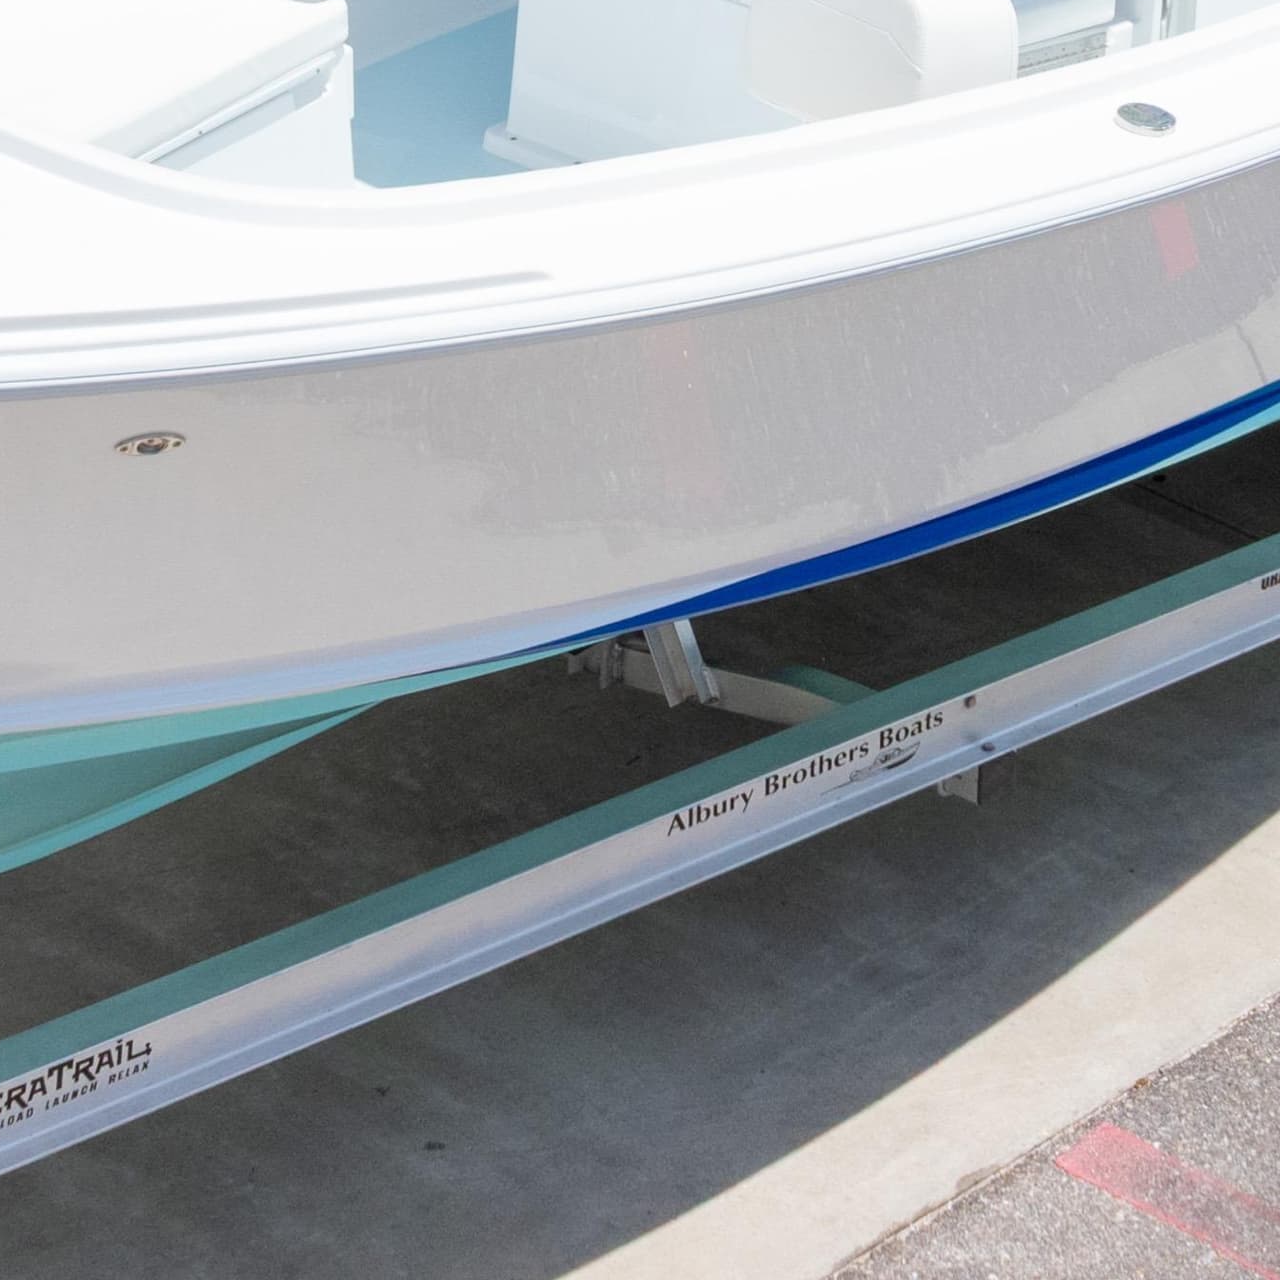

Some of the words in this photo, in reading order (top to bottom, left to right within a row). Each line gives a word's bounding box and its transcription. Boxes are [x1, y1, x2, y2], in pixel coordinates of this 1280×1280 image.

[666, 787, 754, 838] Albury
[764, 741, 870, 797] Brothers
[878, 711, 944, 751] Boats
[0, 1106, 35, 1130] LOAD
[44, 1082, 98, 1111] LAUNCH
[107, 1060, 151, 1085] RELAX
